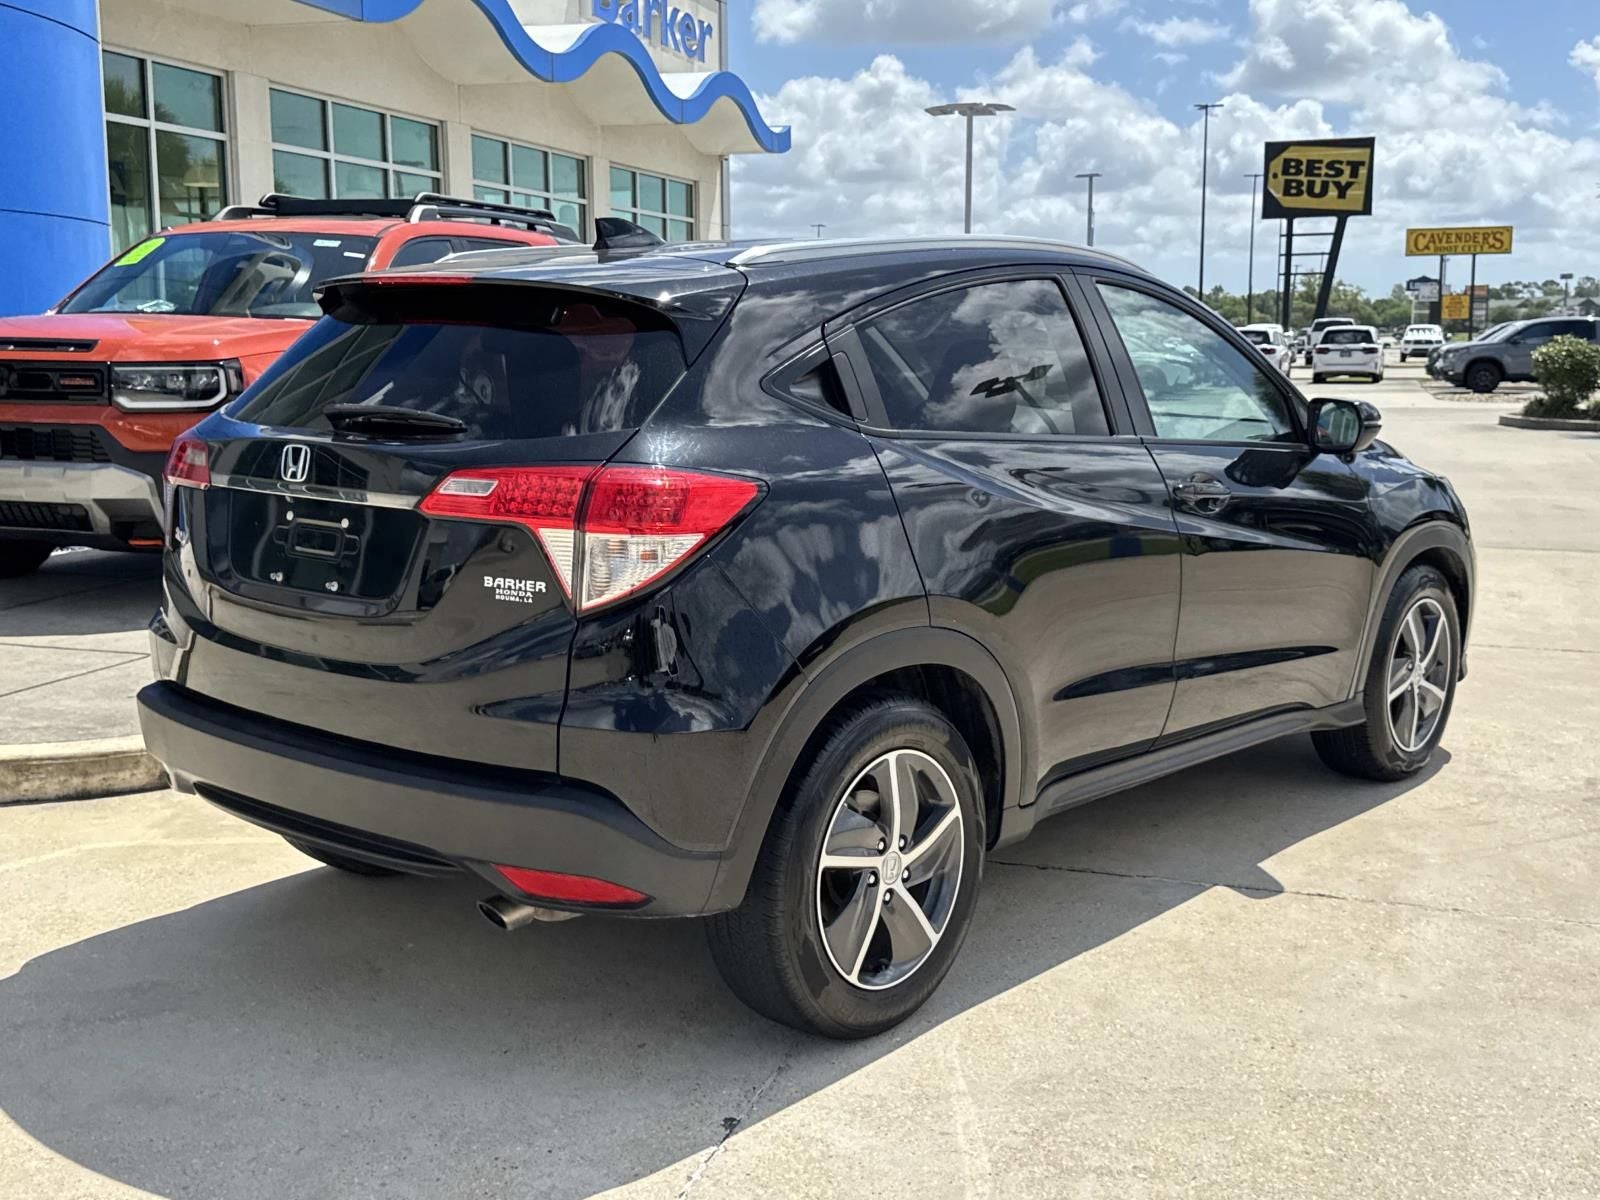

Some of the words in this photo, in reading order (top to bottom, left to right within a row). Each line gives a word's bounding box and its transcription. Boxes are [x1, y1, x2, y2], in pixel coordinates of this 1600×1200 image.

[1281, 158, 1366, 179] BEST
[1282, 178, 1356, 199] BUY
[1413, 230, 1505, 252] CAVENDER'S
[483, 576, 546, 592] BARKER
[495, 588, 533, 597] HONDA
